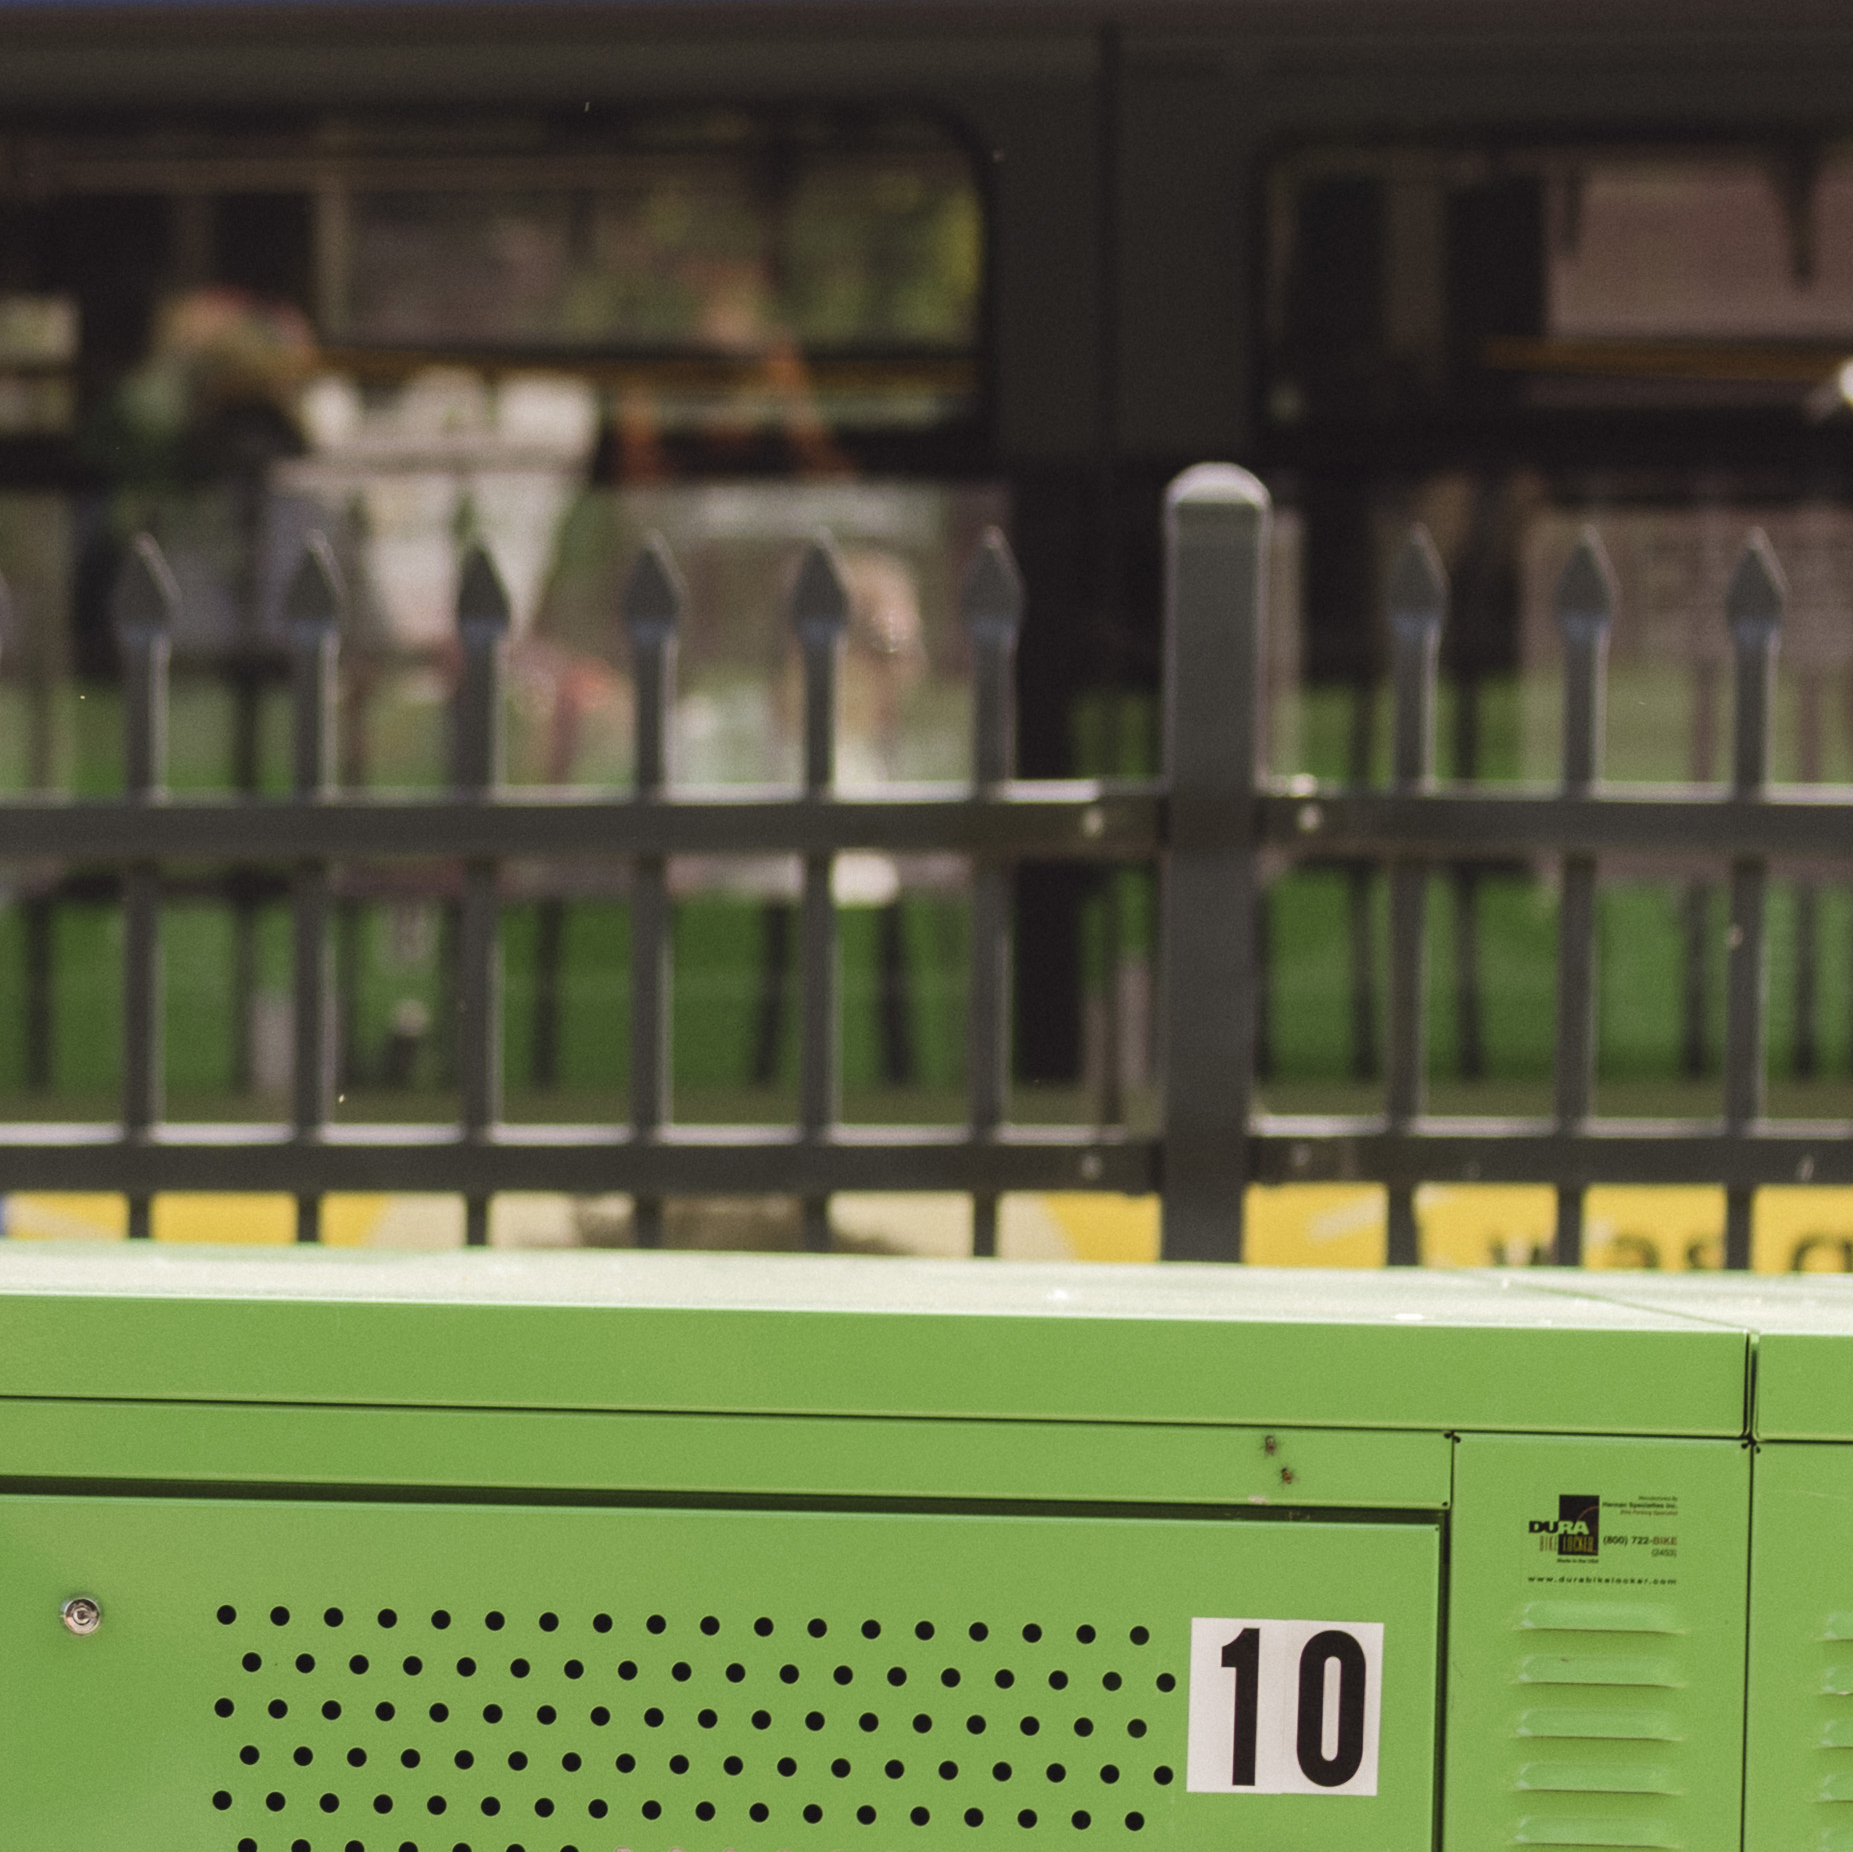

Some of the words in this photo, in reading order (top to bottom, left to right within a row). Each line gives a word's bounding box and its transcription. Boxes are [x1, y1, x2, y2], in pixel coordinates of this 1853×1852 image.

[1528, 1519, 1590, 1535] DURA
[1602, 1534, 1629, 1546] (800)
[1632, 1536, 1676, 1546] 722-BIKE
[1219, 1627, 1368, 1788] 10
